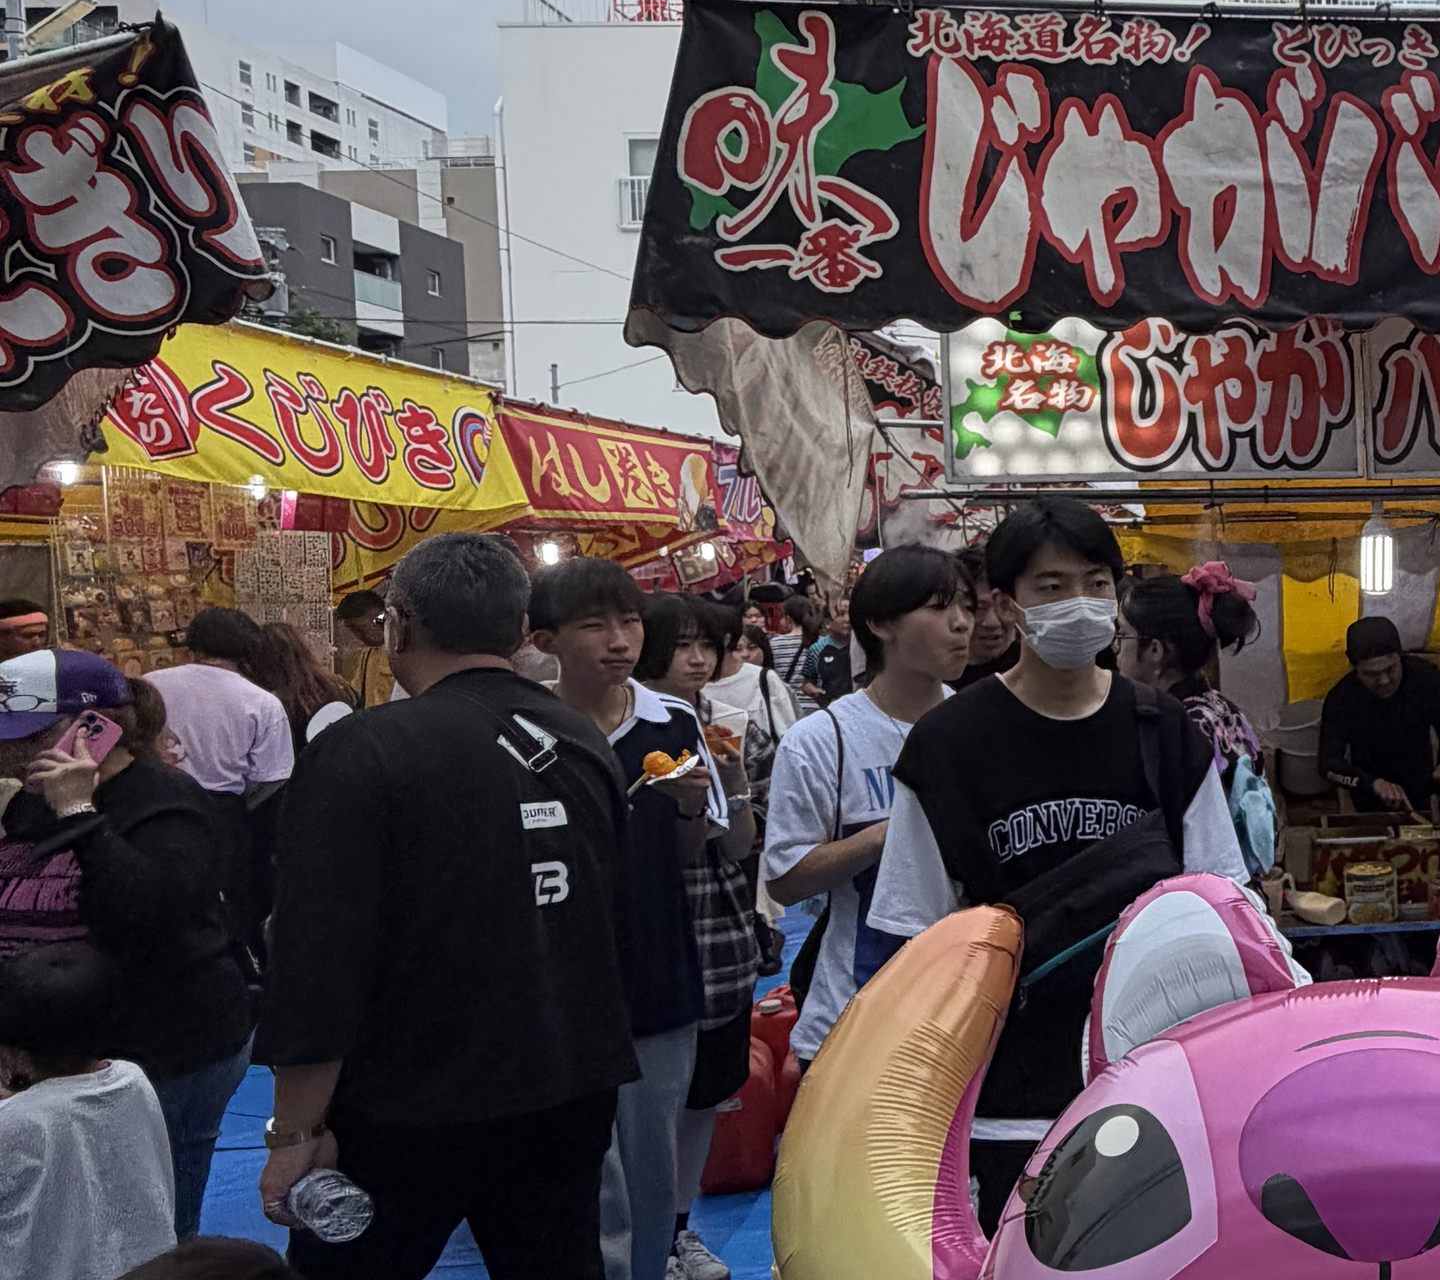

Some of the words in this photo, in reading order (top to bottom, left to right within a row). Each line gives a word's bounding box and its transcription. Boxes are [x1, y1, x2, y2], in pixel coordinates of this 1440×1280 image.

[982, 340, 1083, 379] 北海
[191, 359, 456, 492] くじびき
[998, 378, 1101, 414] 名物
[528, 429, 678, 510] はし巻き
[988, 798, 1148, 864] CONVER
